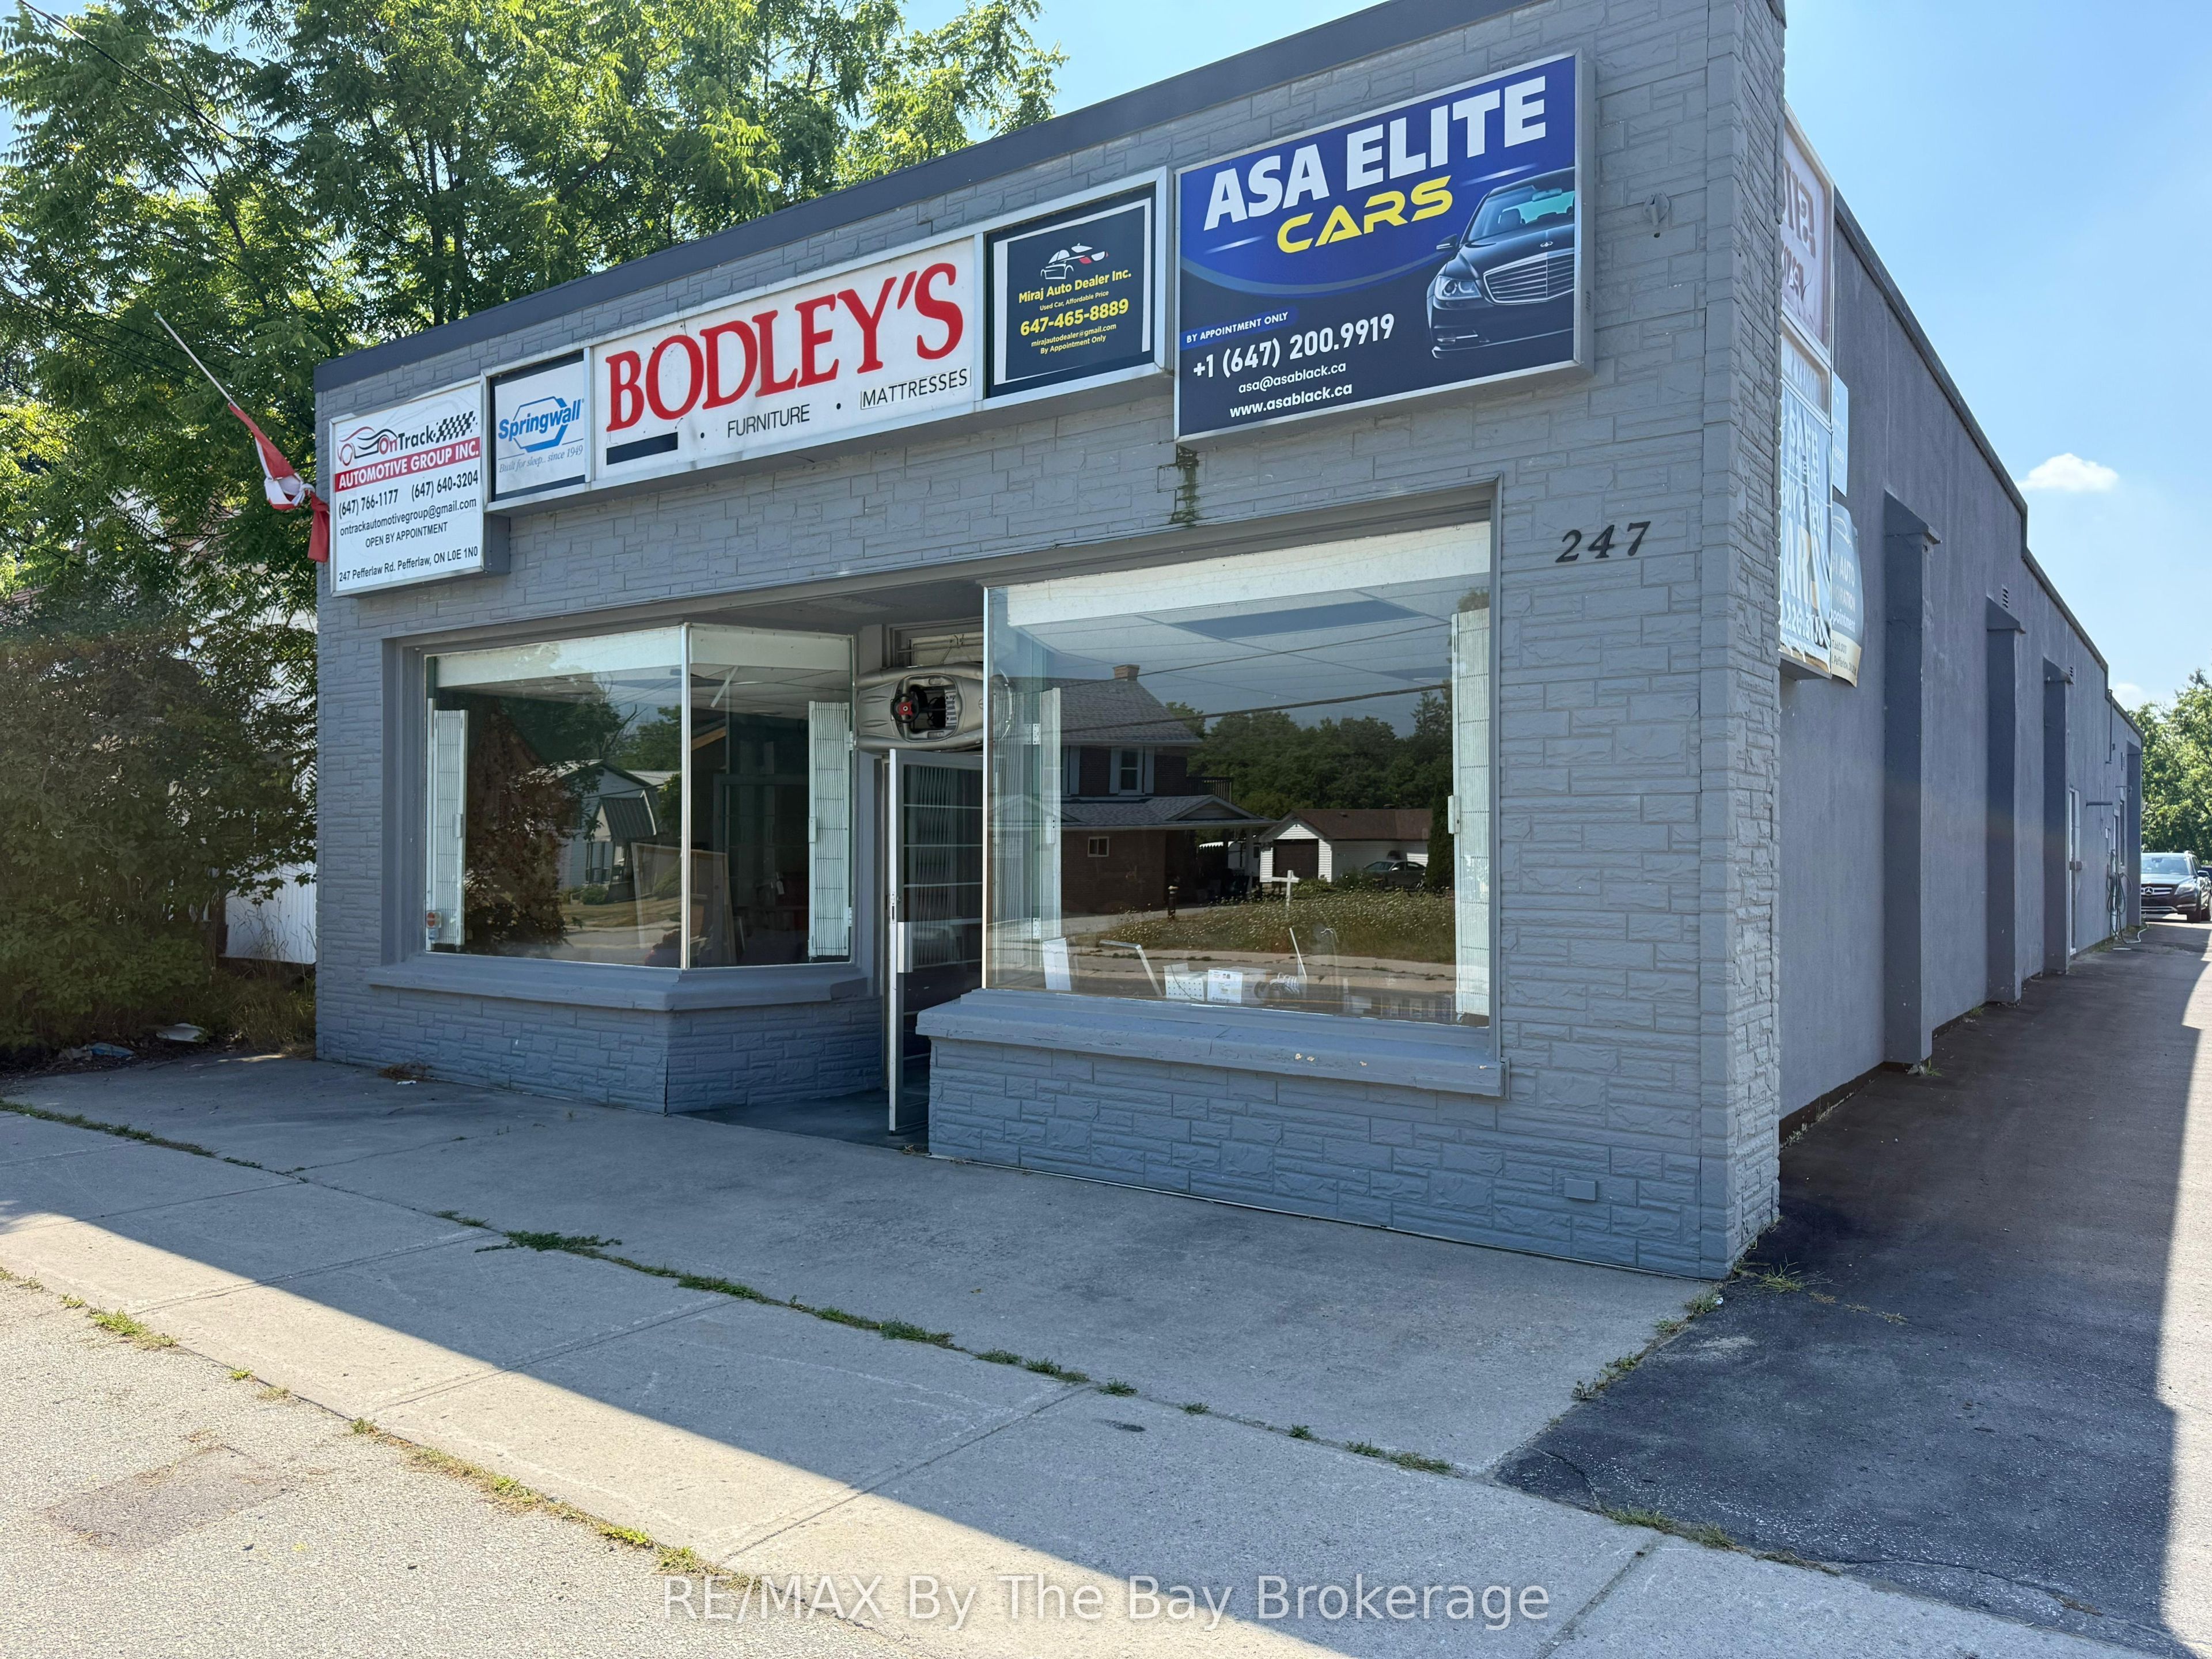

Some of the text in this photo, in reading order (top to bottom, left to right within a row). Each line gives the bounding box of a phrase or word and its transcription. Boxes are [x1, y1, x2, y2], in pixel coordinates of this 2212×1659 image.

[1203, 75, 1547, 231] ASA ELITE
[1277, 175, 1453, 253] CARS
[1018, 269, 1131, 303] Miraj Auto Dealer Inc.
[1040, 290, 1109, 311] Used Car, Affordable Price
[1020, 298, 1129, 336] 647-465-8889
[1186, 311, 1288, 344] BY APPOINTMENT ONLY
[605, 263, 964, 433] BODLEY'S
[1031, 323, 1116, 347] mirajautodealer@gmail.com
[1050, 339, 1090, 353] Appointment
[1092, 335, 1106, 345] Only
[1194, 313, 1395, 378] +1 (647) 200.9919
[1238, 362, 1346, 393] asa@asablack.ca
[728, 369, 967, 438] FURNITURE MATTRESSES
[1229, 384, 1353, 418] www.asablack.ca
[498, 399, 581, 441] Springwall
[378, 425, 434, 454] OnTrack
[339, 441, 479, 490] AUTOMOTIVE GROUP INC.
[499, 460, 515, 473] Built
[515, 459, 526, 472] for
[548, 450, 565, 462] since
[567, 445, 584, 457] 1949
[339, 470, 478, 520] (647) 766-1177 (647) 640-3204
[340, 498, 476, 536] ontrackautomotivegroup@gmail.com
[365, 521, 448, 548] OPEN BY APPOINTMENT
[1555, 521, 1651, 563] 247
[339, 571, 350, 582] 247
[353, 566, 383, 580] Pefferlaw
[384, 563, 396, 573] Rd.
[397, 556, 431, 570] Pefferlaw,
[434, 551, 445, 564] ON
[1839, 555, 1855, 588] AUTO
